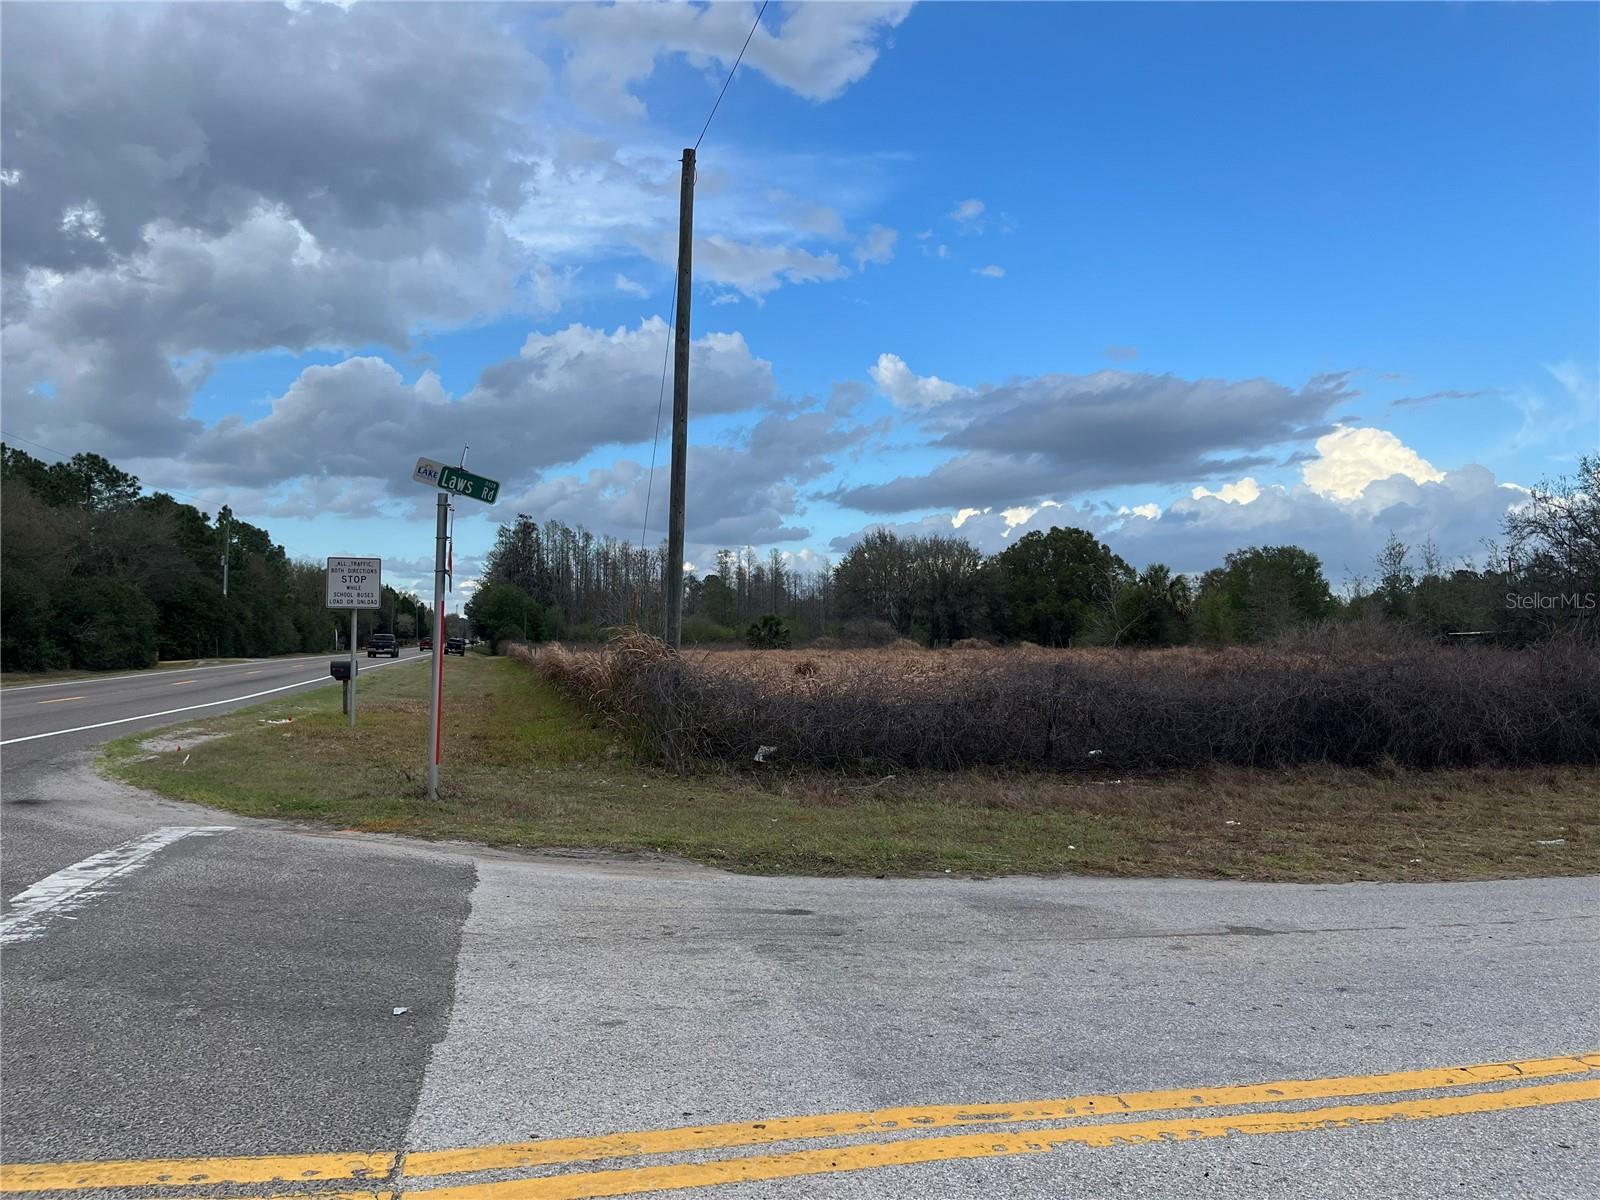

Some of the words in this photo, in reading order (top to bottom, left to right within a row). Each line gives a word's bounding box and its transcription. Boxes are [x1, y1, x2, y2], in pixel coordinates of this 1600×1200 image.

[417, 466, 439, 479] LAKE
[441, 469, 474, 494] Laws
[480, 487, 495, 501] Rd
[341, 575, 367, 583] STOP
